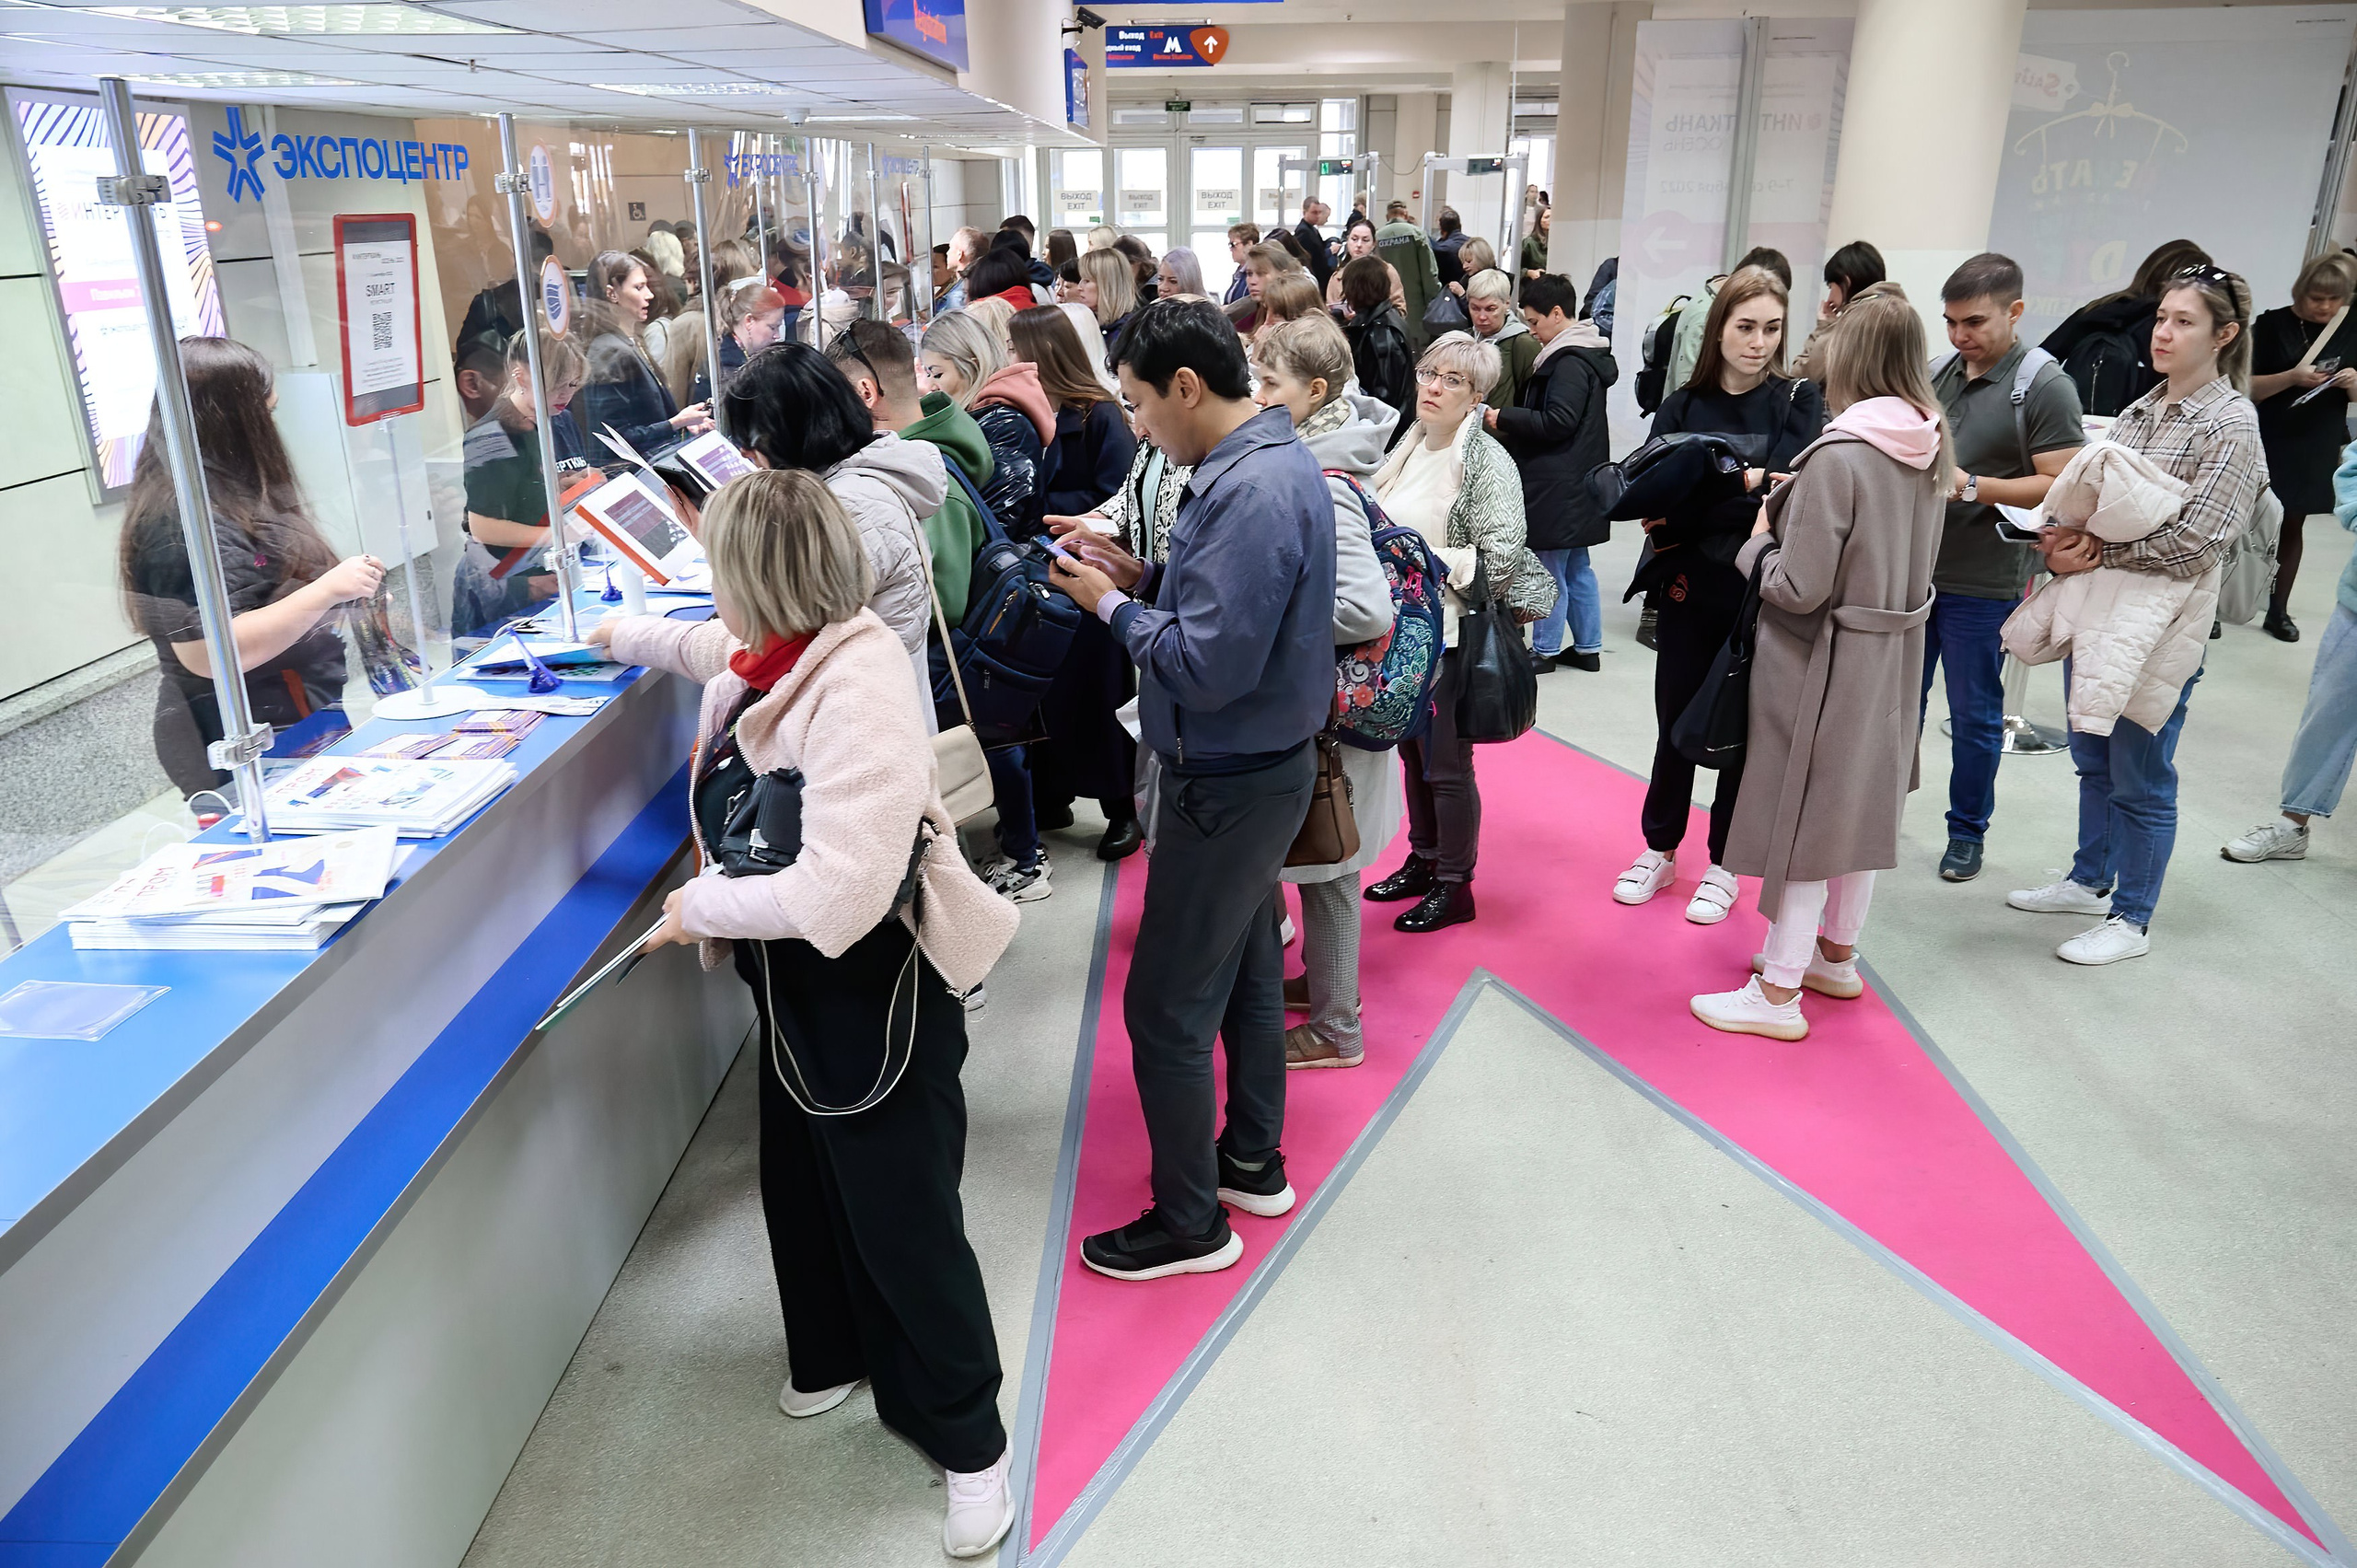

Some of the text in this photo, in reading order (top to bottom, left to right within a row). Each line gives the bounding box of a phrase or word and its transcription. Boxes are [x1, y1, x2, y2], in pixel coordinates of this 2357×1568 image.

[1119, 30, 1145, 41] Выход
[272, 134, 469, 184] ЭКСПОЦЕНТР
[1060, 192, 1092, 201] ВЫХОД
[1378, 236, 1411, 248] ОХРАНА
[366, 282, 396, 296] SMART
